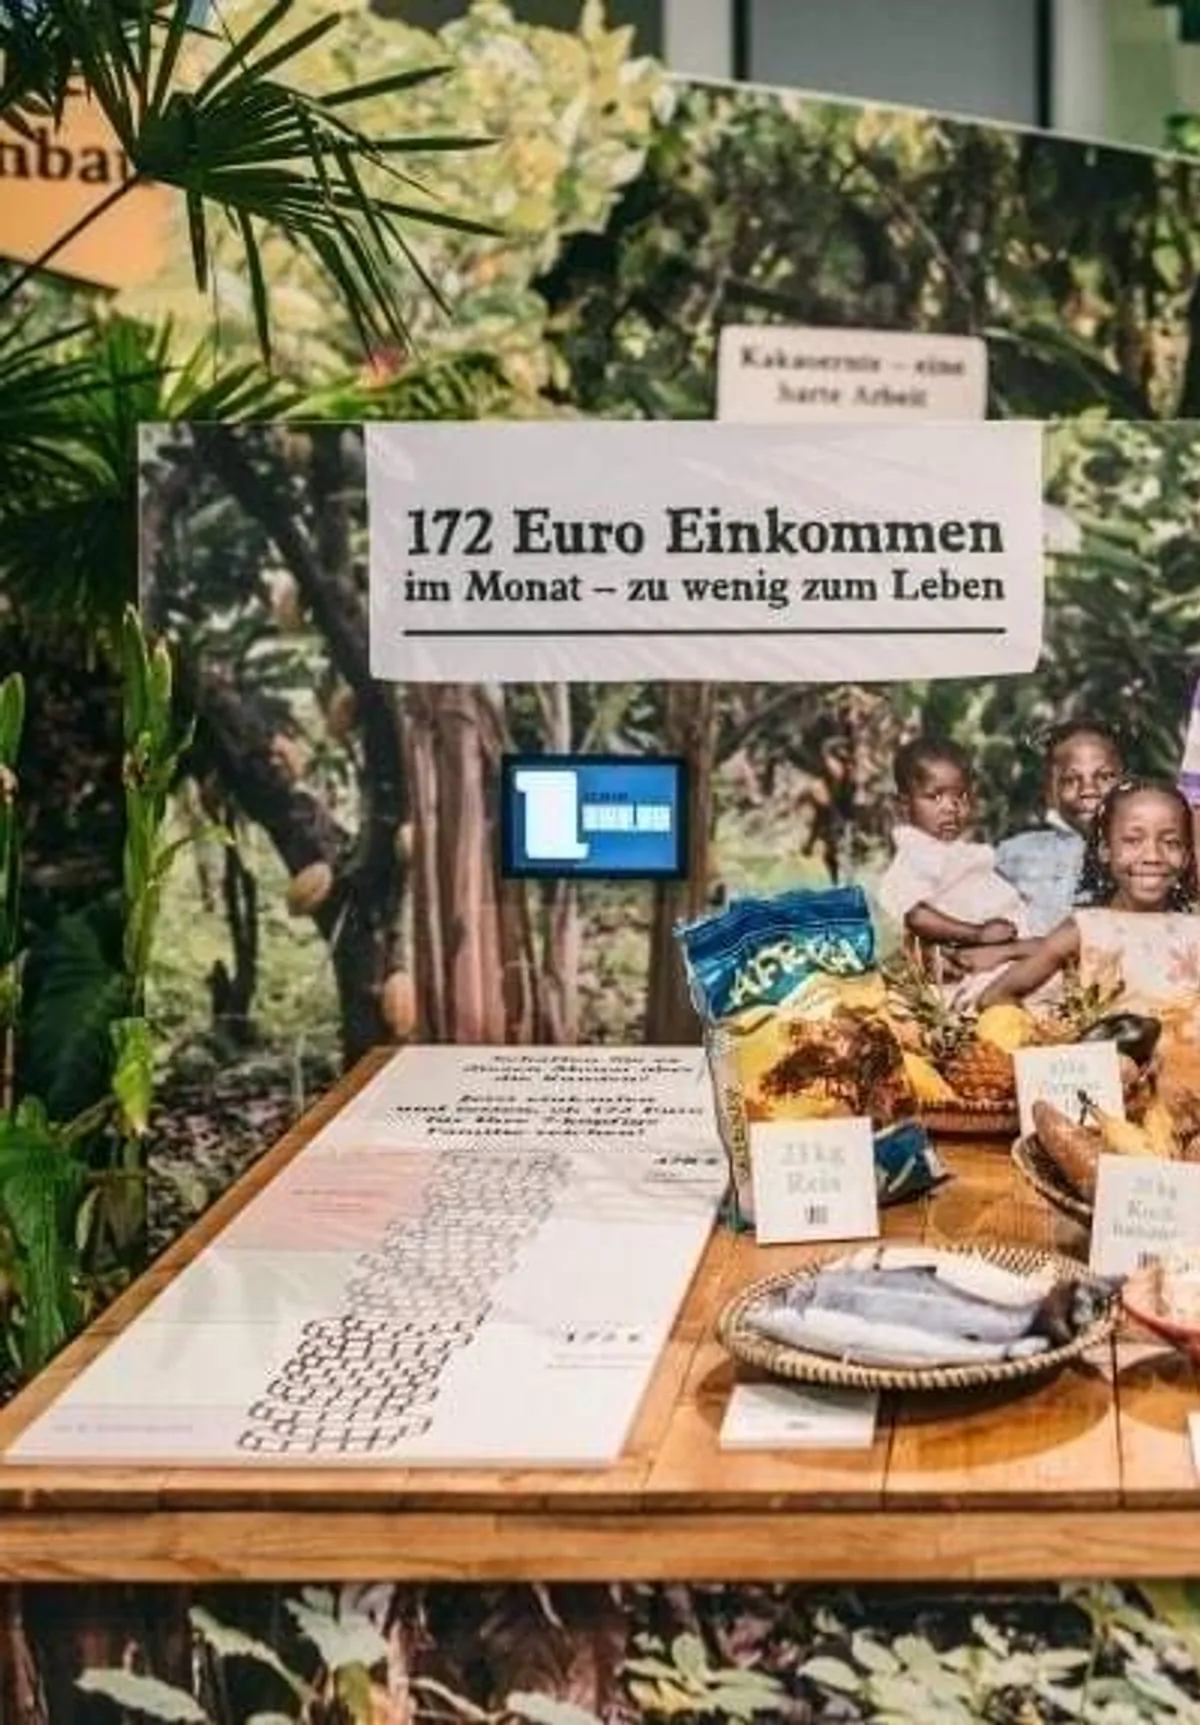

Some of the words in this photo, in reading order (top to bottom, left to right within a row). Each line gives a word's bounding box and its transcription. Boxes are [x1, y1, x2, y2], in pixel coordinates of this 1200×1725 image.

[407, 508, 493, 556] 172
[512, 508, 645, 555] Euro
[665, 506, 1004, 555] Einkommen
[404, 570, 450, 601] im
[464, 569, 582, 601] Monat
[628, 579, 669, 601] zu
[681, 568, 790, 609] wenig
[801, 577, 877, 601] zum
[890, 568, 1004, 601] Leben
